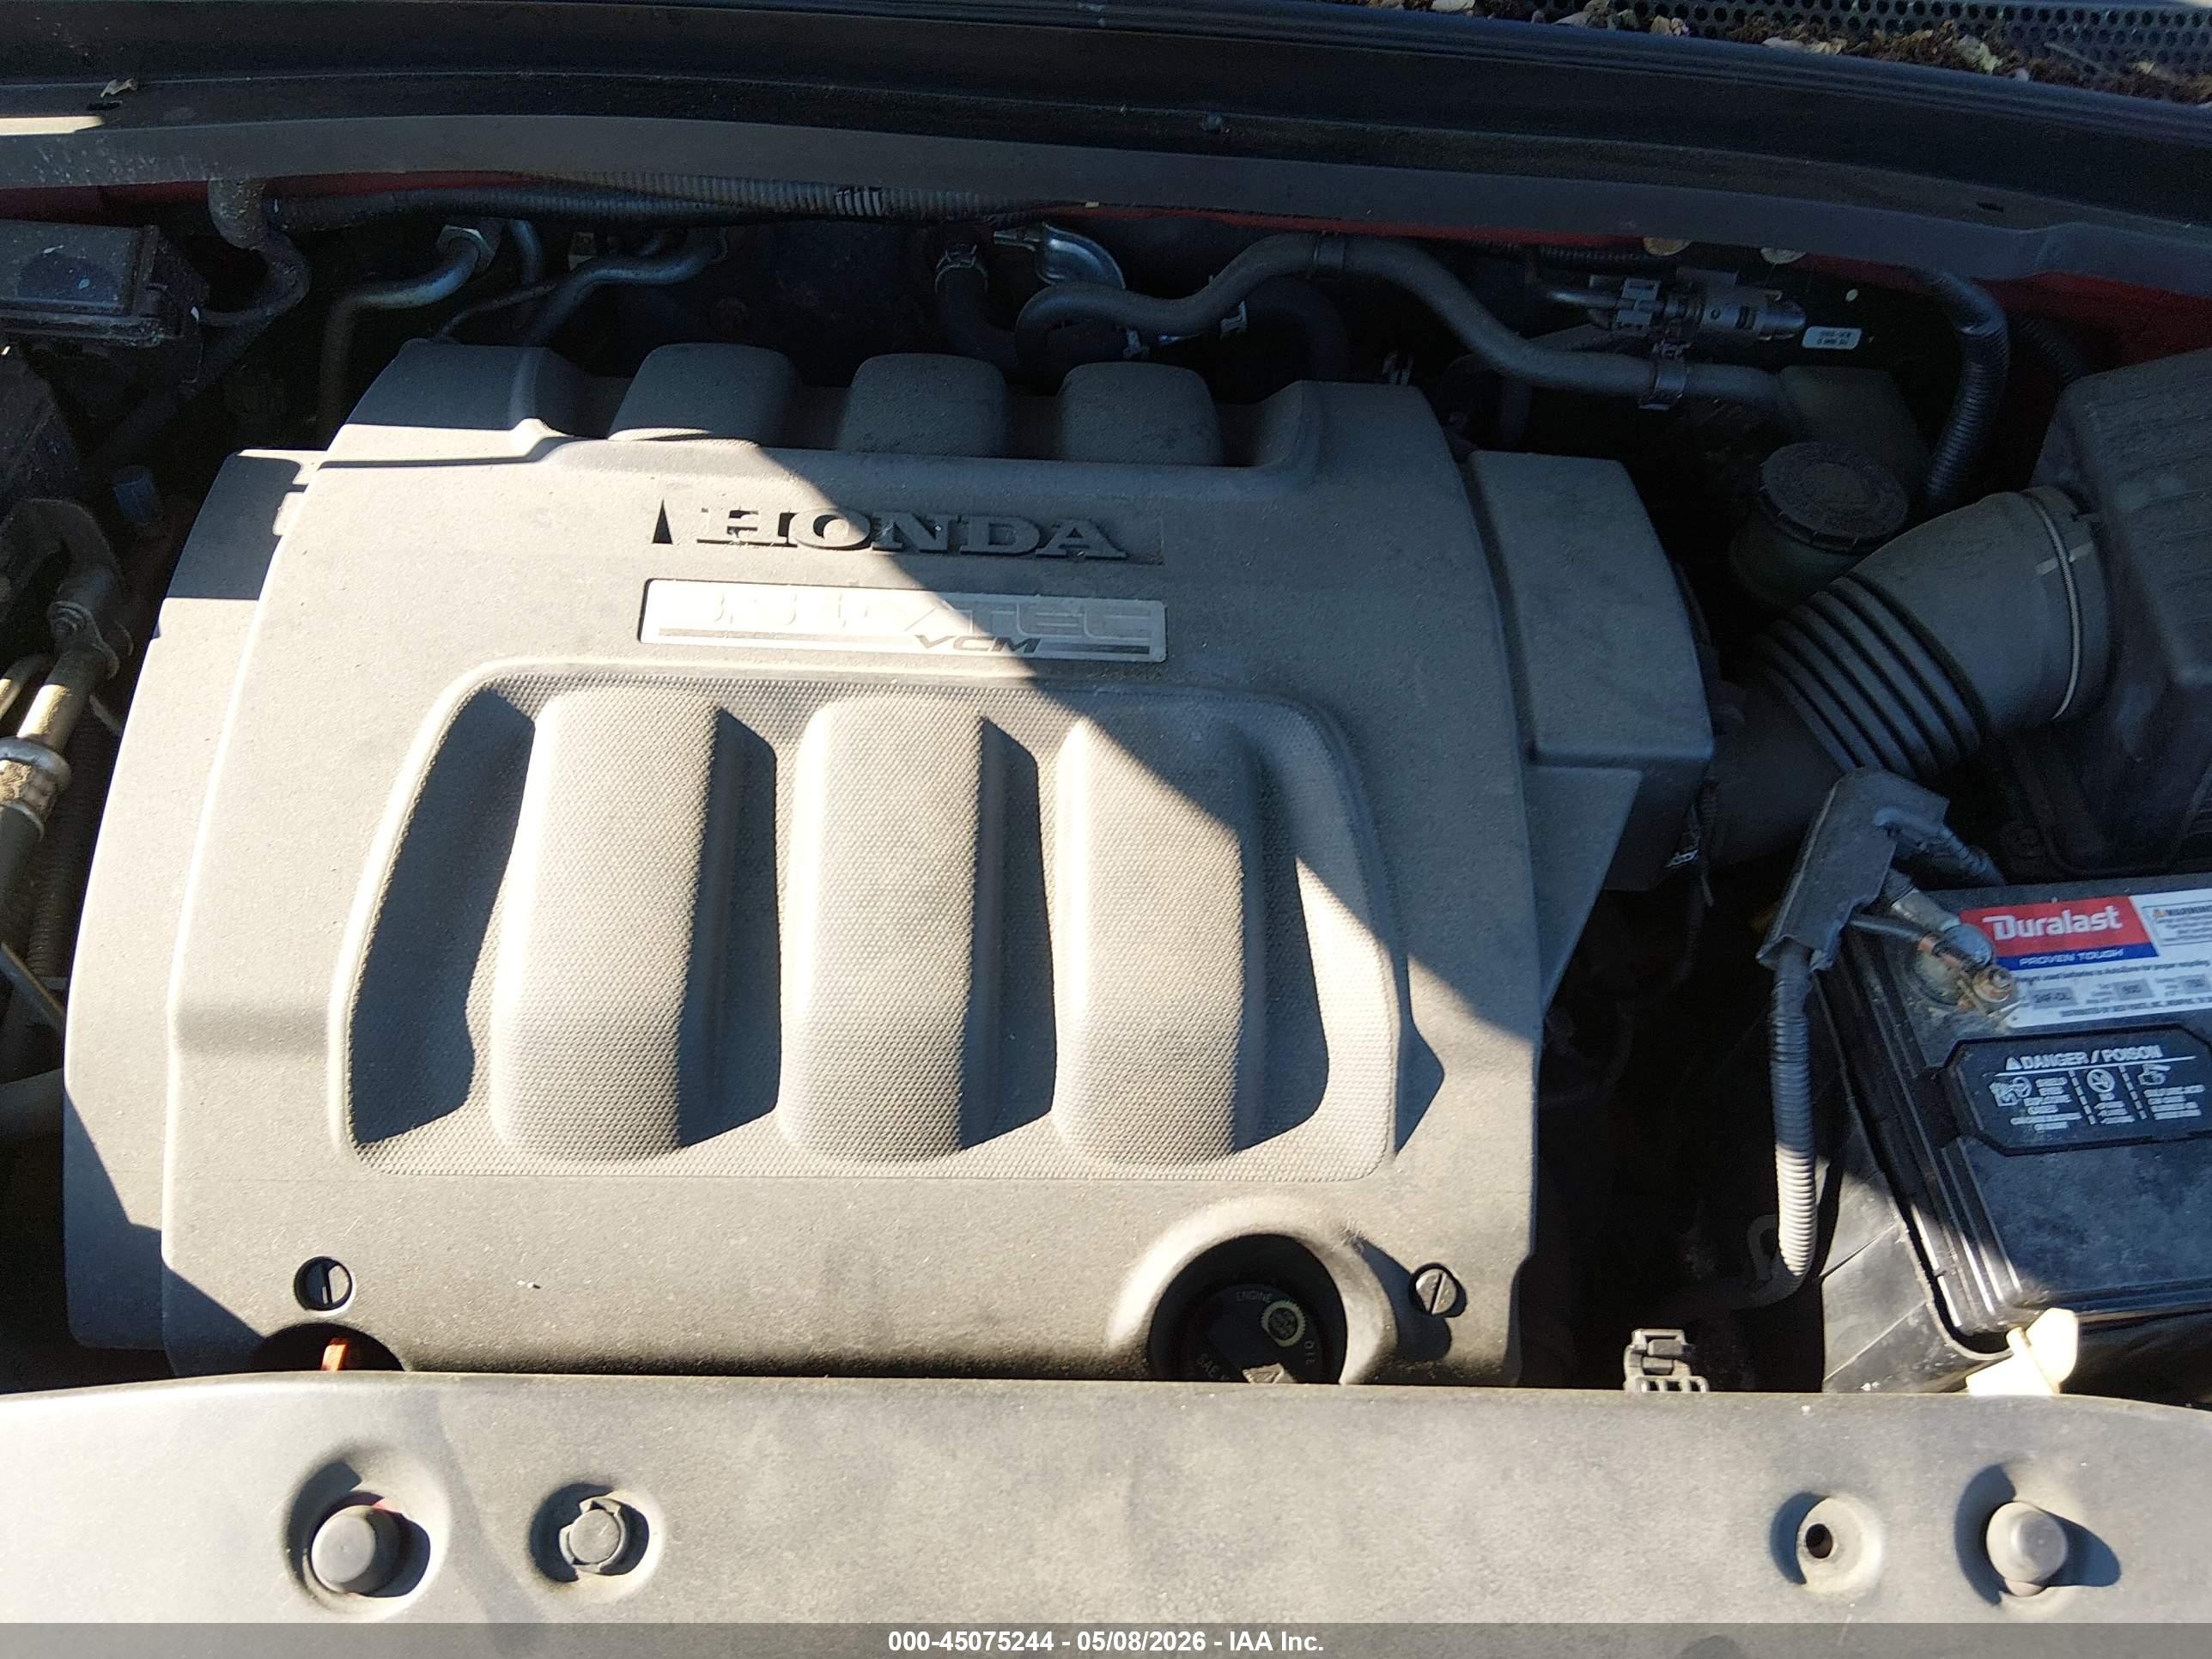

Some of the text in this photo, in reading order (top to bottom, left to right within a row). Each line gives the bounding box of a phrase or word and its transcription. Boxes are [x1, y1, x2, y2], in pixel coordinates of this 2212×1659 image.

[696, 507, 1127, 560] HONDA
[915, 634, 1042, 654] VCM
[1982, 904, 2124, 941] Duralast
[2019, 948, 2124, 967] PROVEN TOUGH
[2020, 1051, 2089, 1070] DANGER
[2100, 1044, 2163, 1062] POISON
